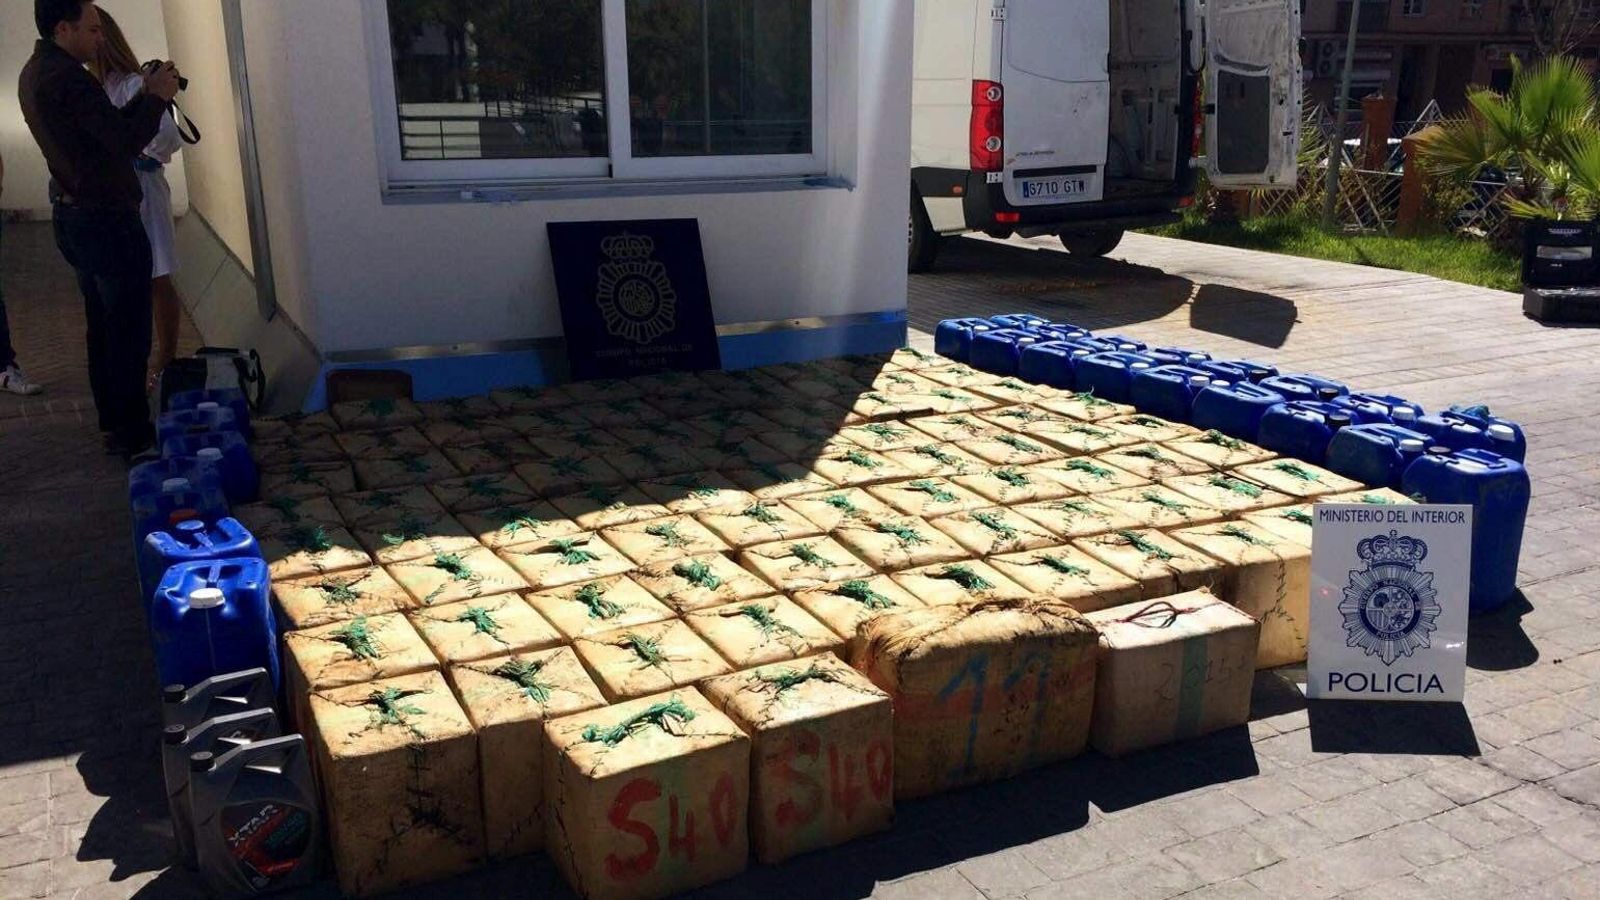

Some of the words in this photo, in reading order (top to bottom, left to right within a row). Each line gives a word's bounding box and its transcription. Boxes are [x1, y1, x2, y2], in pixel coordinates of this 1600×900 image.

[1029, 181, 1058, 195] 6710
[1064, 180, 1085, 194] GTW
[1319, 509, 1384, 523] MINISTERIO
[1387, 510, 1408, 524] DEL
[1411, 510, 1466, 524] INTERIOR
[1328, 671, 1445, 694] POLICIA
[766, 728, 893, 829] S40
[605, 773, 737, 881] S40
